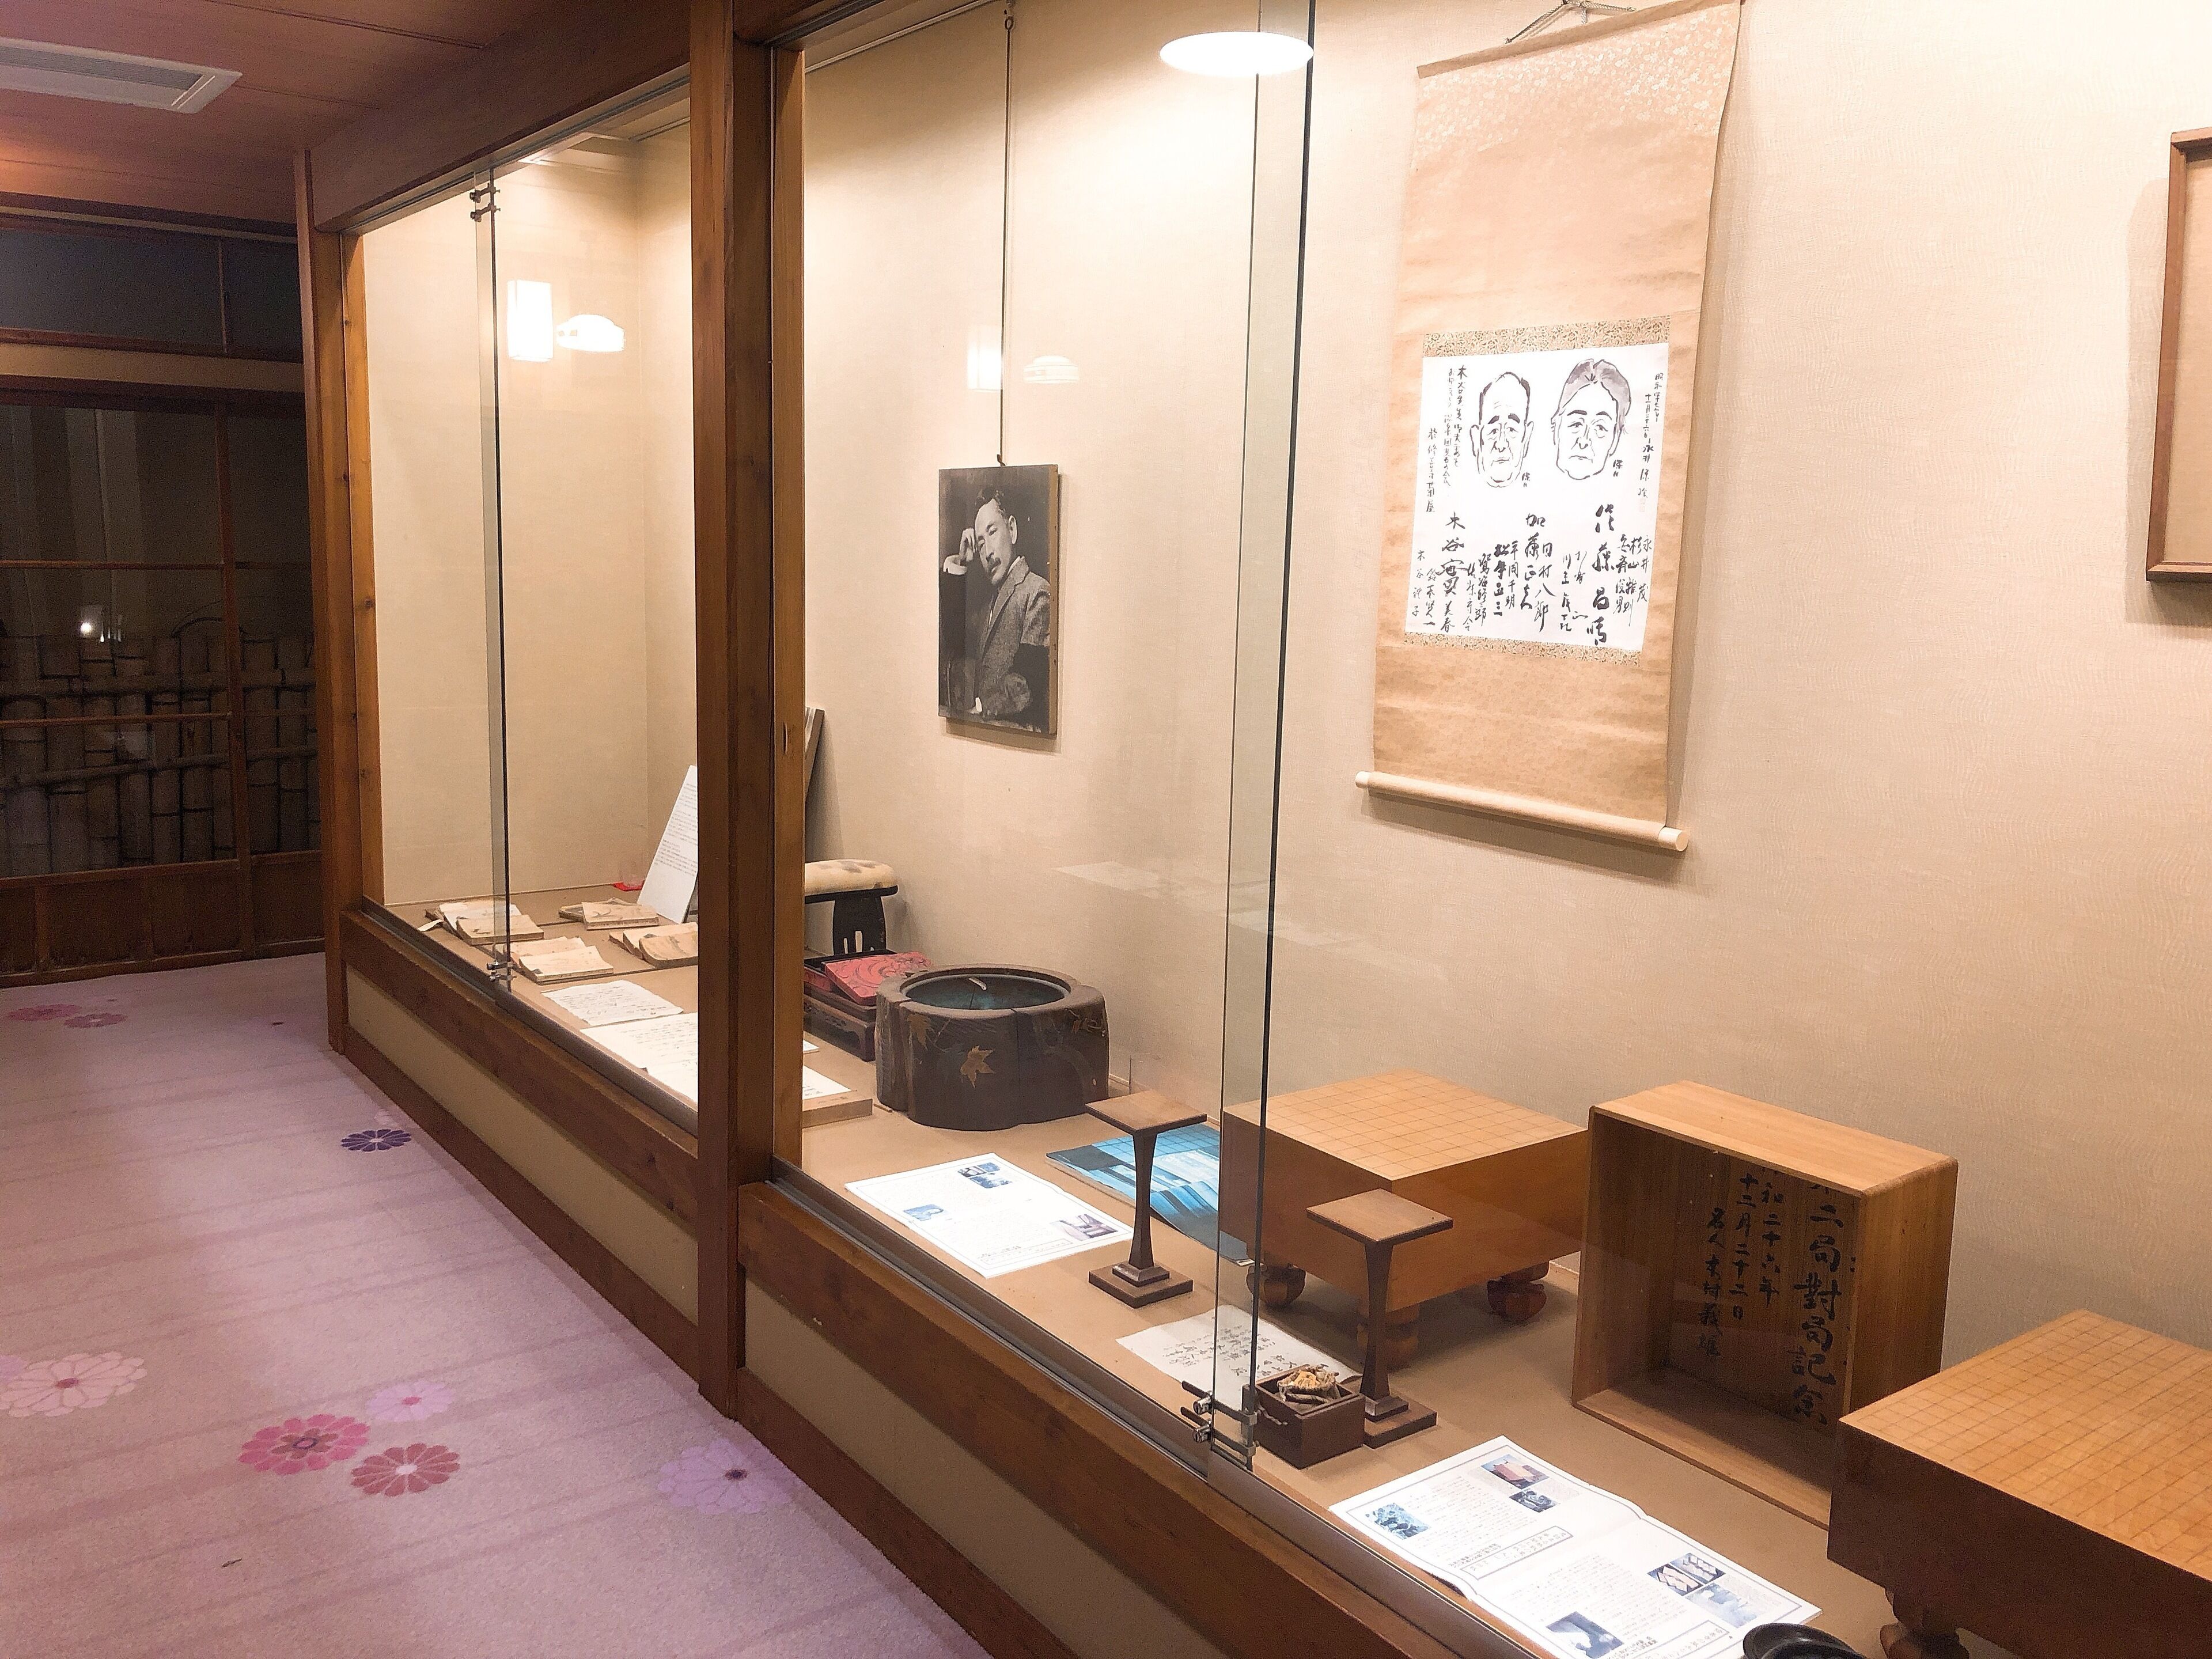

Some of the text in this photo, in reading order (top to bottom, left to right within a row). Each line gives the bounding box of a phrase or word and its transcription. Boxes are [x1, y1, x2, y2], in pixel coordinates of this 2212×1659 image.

[1786, 1183, 1844, 1426] 二局對局記念
